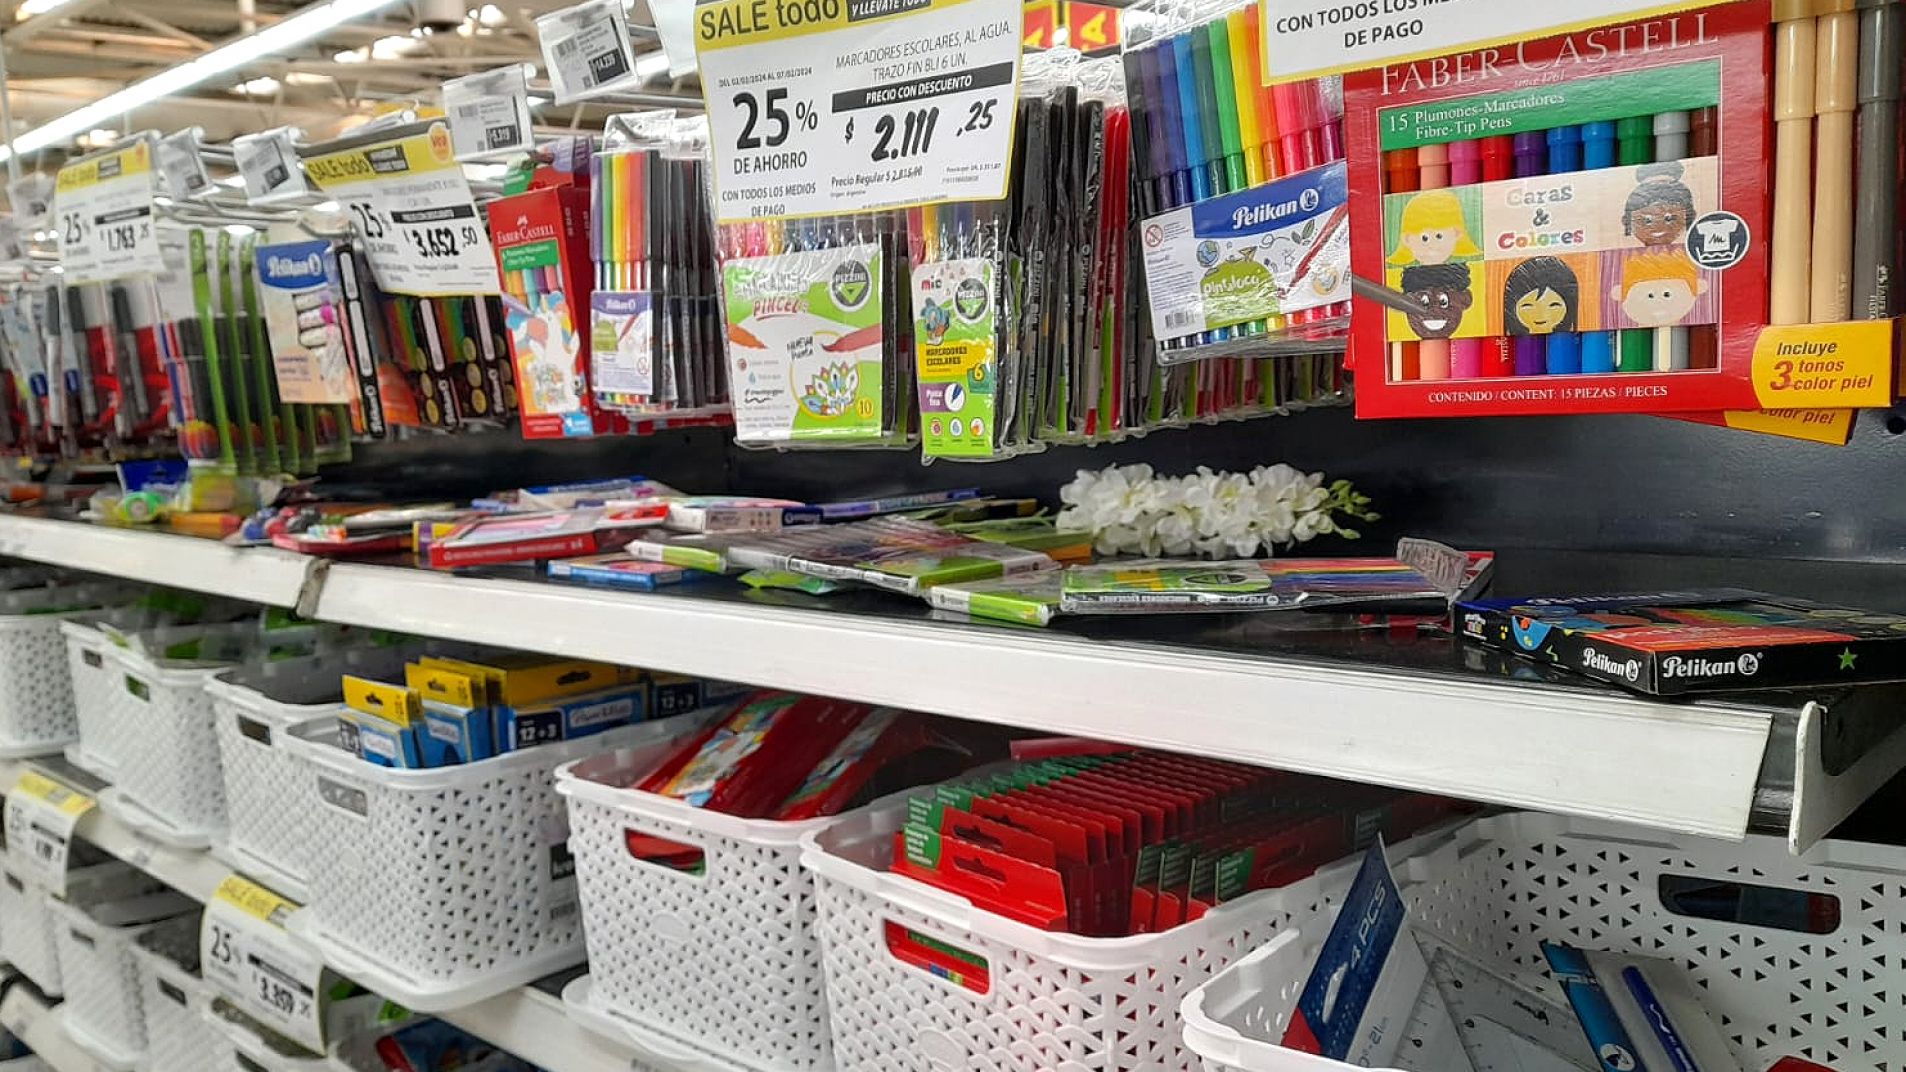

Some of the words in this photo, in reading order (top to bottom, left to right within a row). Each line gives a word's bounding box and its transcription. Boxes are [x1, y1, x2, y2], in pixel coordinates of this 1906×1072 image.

[701, 1, 769, 40] SALE
[776, 0, 839, 27] todo
[1276, 14, 1313, 34] CON
[1317, 0, 1378, 26] TODOS
[1344, 32, 1367, 48] DE
[1372, 19, 1424, 43] PAGO
[836, 45, 901, 68] MARCADORES
[965, 28, 976, 44] AL
[1380, 13, 1719, 97] FABER-CASTELL
[873, 63, 905, 81] TRAZO
[907, 60, 922, 76] FIN
[866, 88, 896, 105] PRECIO
[898, 82, 916, 98] CON
[918, 75, 972, 95] DESCUENTO
[1389, 112, 1408, 132] 15
[1415, 92, 1565, 124] Plumones-Marcadores
[845, 116, 854, 143] $
[1415, 119, 1477, 140] Fibre-Tip
[1480, 115, 1512, 132] Pens
[734, 157, 750, 174] DE
[754, 151, 807, 172] AHORRO
[722, 189, 738, 201] CON
[741, 186, 768, 200] TODOS
[769, 185, 783, 198] LOS
[785, 182, 816, 196] MEDIOS
[1506, 184, 1573, 207] Caras
[751, 206, 760, 217] DE
[764, 203, 786, 216] PAGO
[1232, 199, 1298, 229] Pelikan
[1532, 208, 1550, 227] &
[1498, 229, 1584, 249] Colores
[1776, 341, 1838, 357] Incluye
[974, 364, 984, 381] 6
[1770, 360, 1794, 391] 3
[1798, 360, 1845, 373] tonos
[1793, 376, 1838, 391] color
[1840, 374, 1873, 391] piel
[1428, 390, 1493, 403] CONTENIDO
[1561, 388, 1573, 399] 15
[1574, 386, 1617, 398] PIEZAS
[1626, 385, 1668, 397] PIECES
[859, 400, 872, 415] 10
[1583, 647, 1625, 677] Pelikan
[1663, 656, 1735, 678] Pelikan
[1358, 879, 1386, 945] PCS
